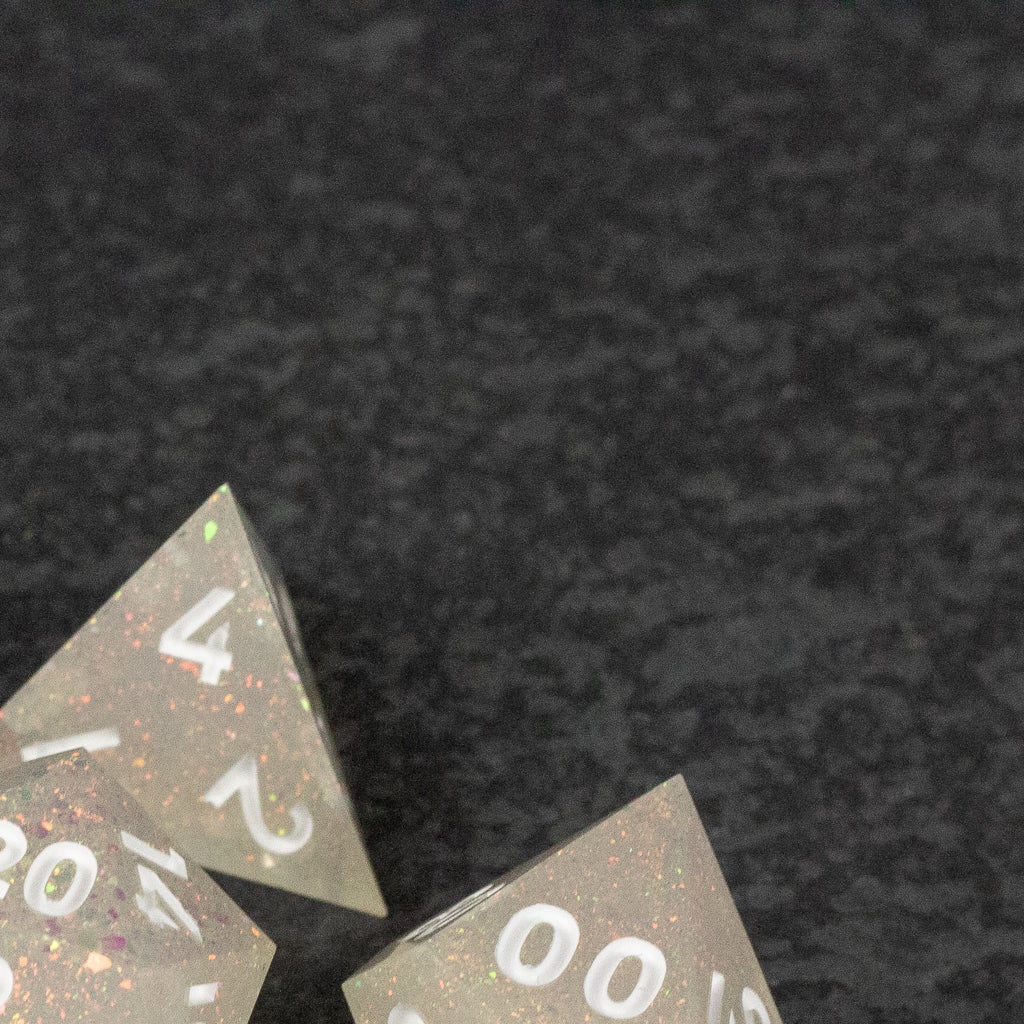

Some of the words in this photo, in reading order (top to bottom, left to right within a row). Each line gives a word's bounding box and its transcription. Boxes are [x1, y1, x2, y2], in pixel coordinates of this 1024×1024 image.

[158, 587, 235, 686] 4
[204, 756, 314, 856] 2
[495, 903, 667, 1019] 00
